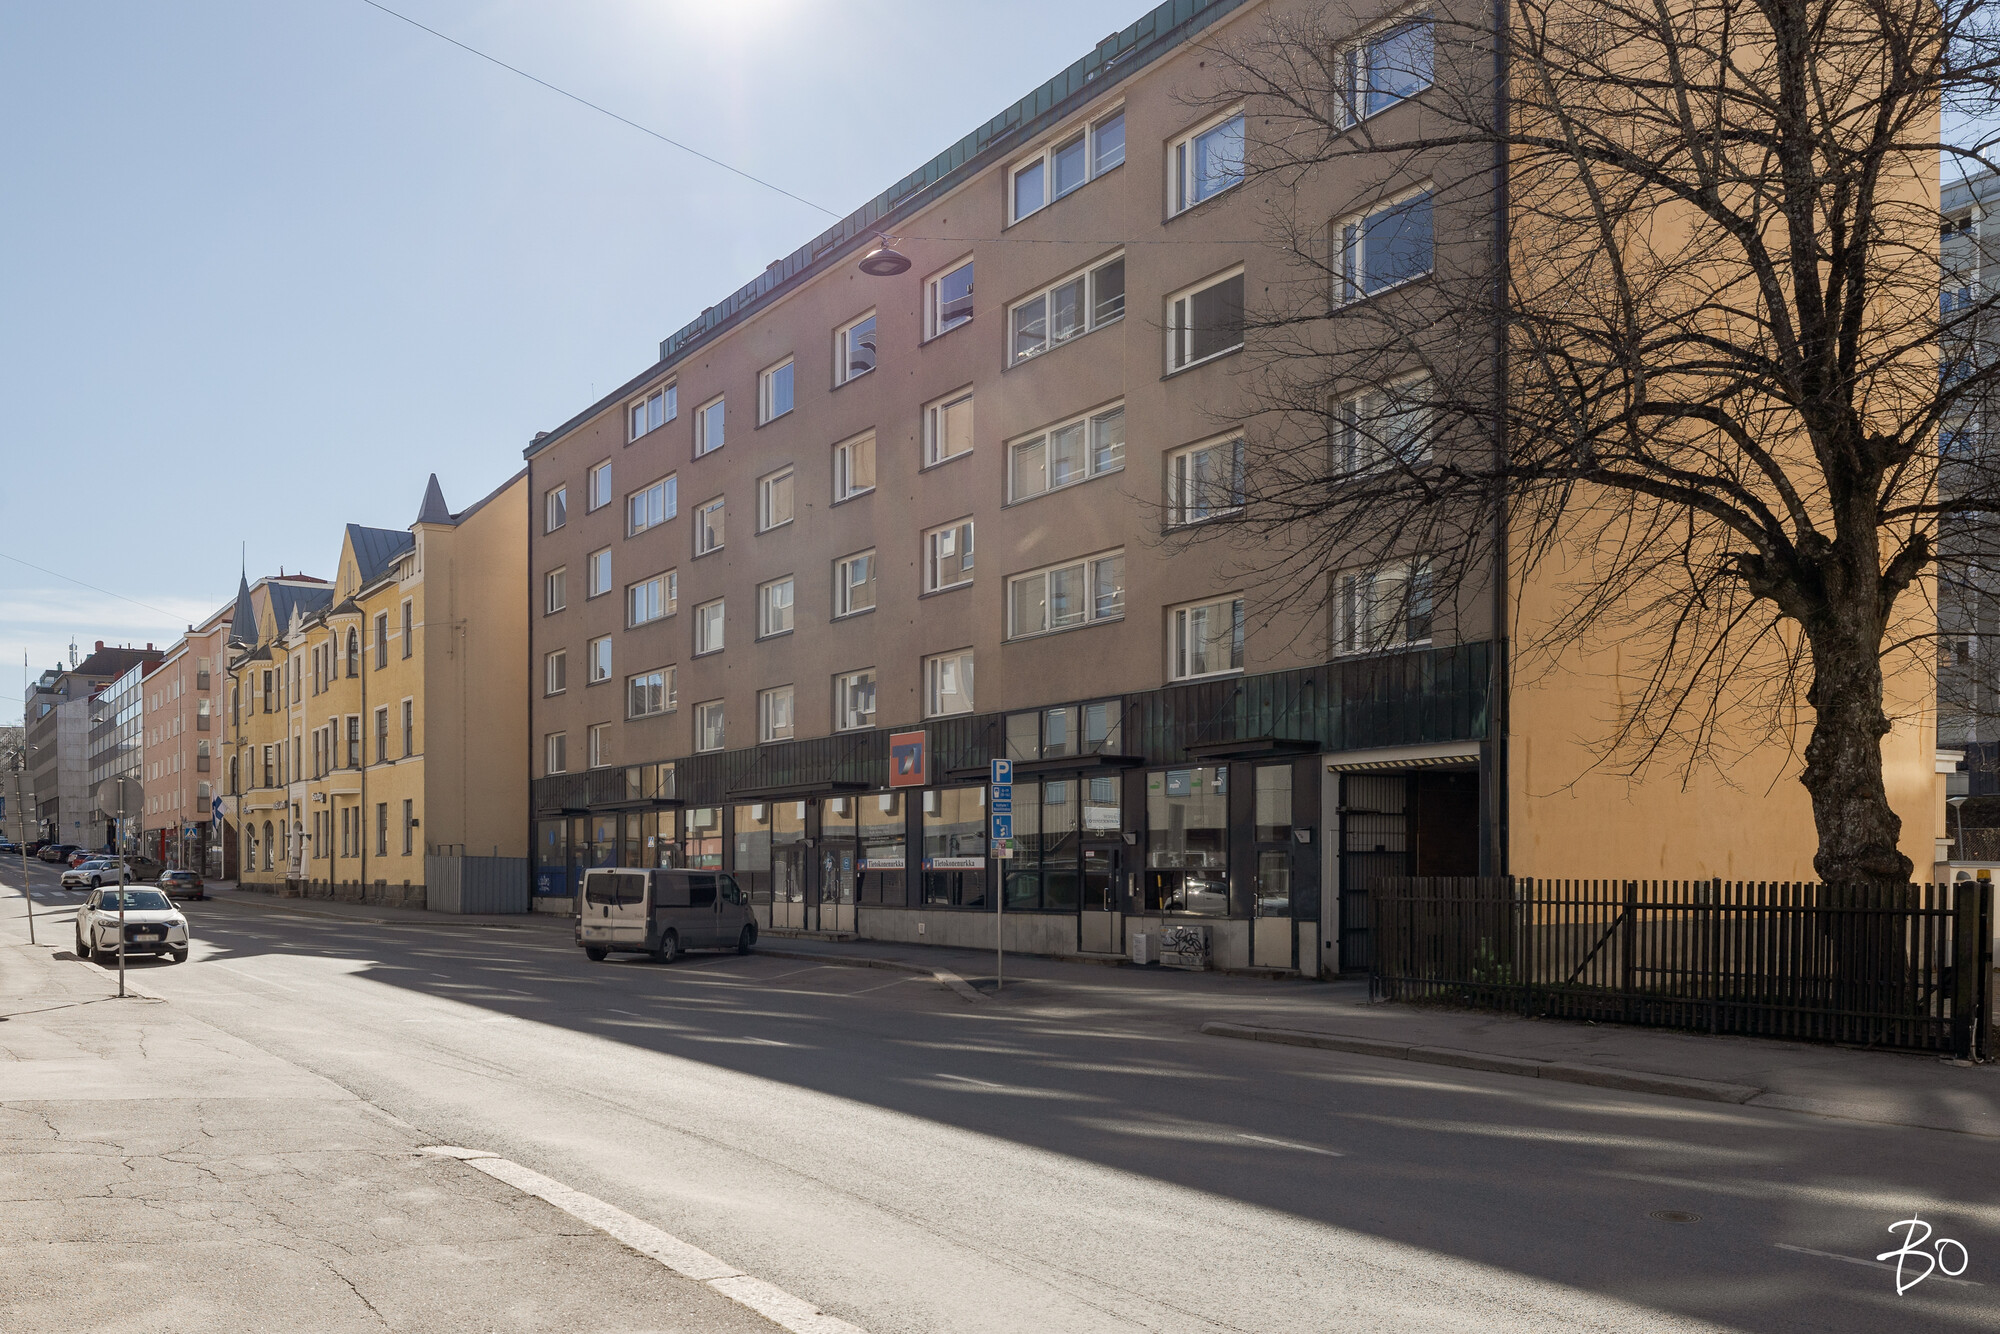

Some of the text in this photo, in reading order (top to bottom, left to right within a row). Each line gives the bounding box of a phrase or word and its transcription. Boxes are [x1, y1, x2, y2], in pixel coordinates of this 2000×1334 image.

[996, 761, 1009, 782] P
[868, 860, 904, 868] Tietokonenurkka
[934, 859, 975, 868] Tietokonenurkka
